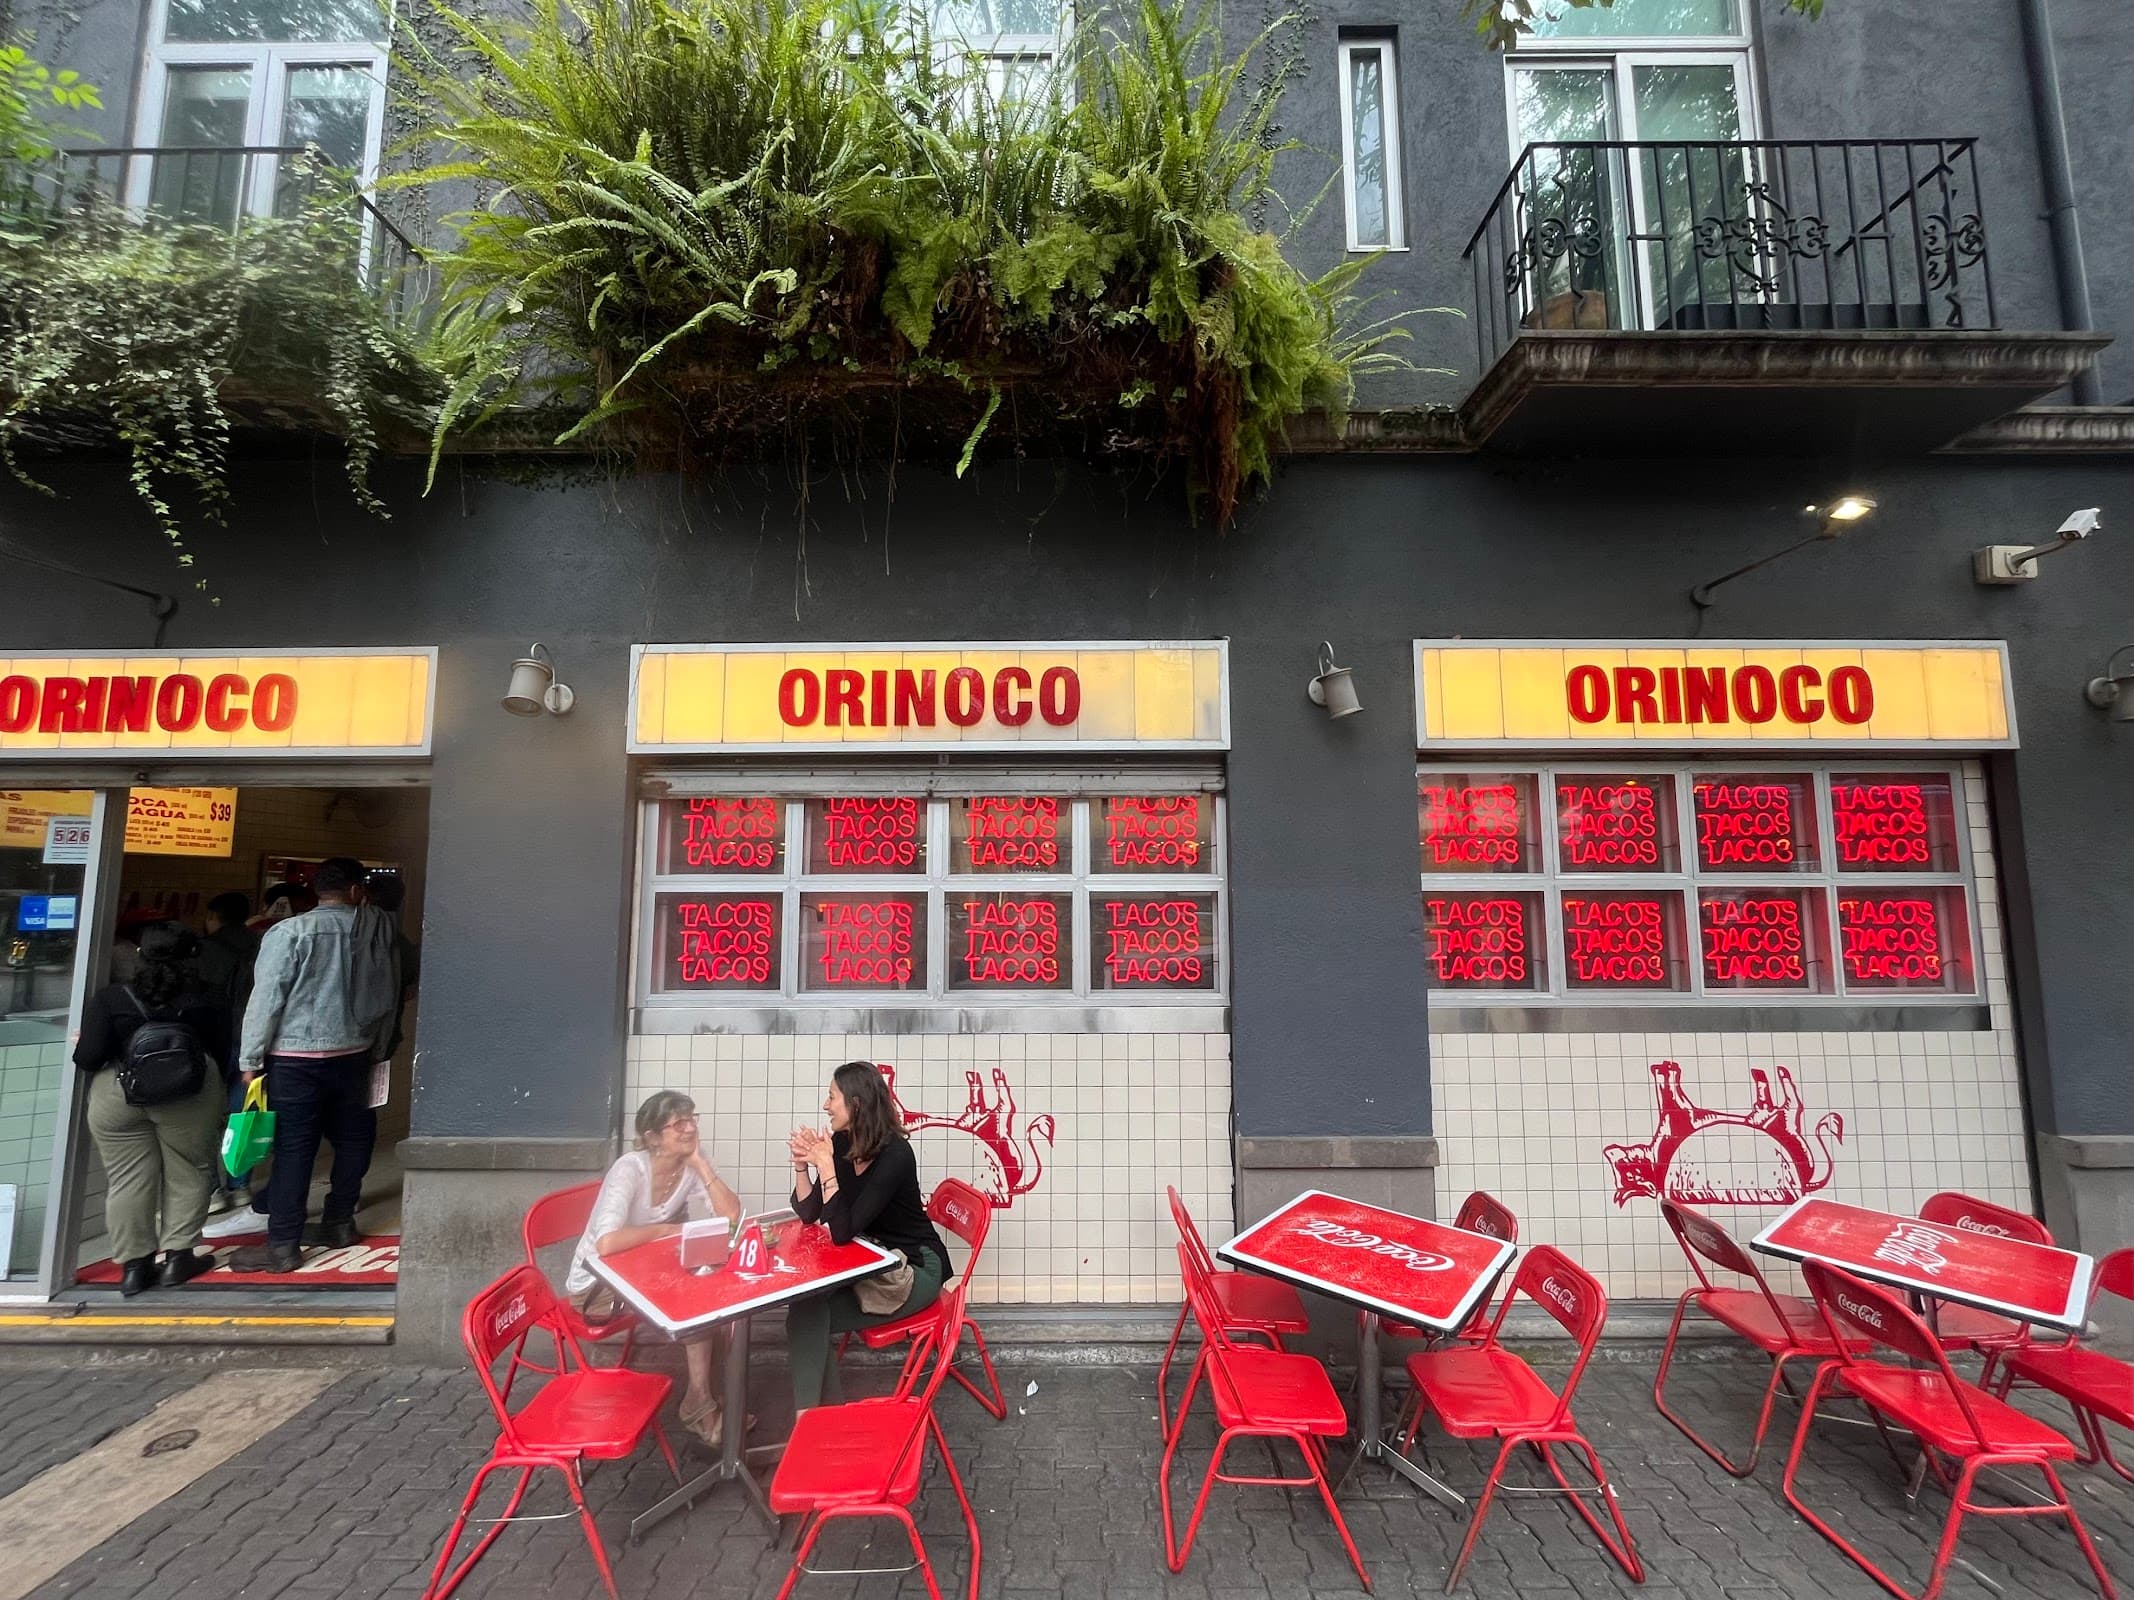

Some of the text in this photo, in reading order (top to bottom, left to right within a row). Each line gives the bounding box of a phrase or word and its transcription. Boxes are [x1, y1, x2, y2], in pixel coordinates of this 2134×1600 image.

[0, 674, 298, 734] ORINOCO
[778, 666, 1081, 727] ORINOCO
[1566, 665, 1874, 724] ORINOCO
[1423, 786, 1517, 810] TACOS
[1560, 787, 1655, 810] TACOS
[1694, 785, 1789, 809] TACOS
[1831, 786, 1923, 809] TACOS
[131, 807, 186, 819] AGUA
[1698, 813, 1790, 836] TACOS
[1834, 812, 1927, 836] TACOS
[682, 814, 777, 839] TACOS
[825, 815, 916, 839] TACOS
[966, 813, 1058, 838] TACOS
[1106, 815, 1198, 839] TACOS
[1426, 814, 1519, 837] TACOS
[1563, 814, 1655, 837] TACOS
[682, 842, 774, 867] TACOS
[825, 841, 916, 866] TACOS
[966, 841, 1058, 866] TACOS
[1108, 841, 1199, 865] TACOS
[1426, 839, 1520, 864] TACOS
[1564, 840, 1657, 864] TACOS
[1701, 839, 1793, 863] TACOS
[1836, 838, 1929, 862] TACOS
[679, 903, 772, 927] TACOS
[819, 903, 913, 928] TACOS
[964, 902, 1056, 926] TACOS
[1106, 902, 1198, 927] TACOS
[1428, 900, 1523, 926] TACOS
[1565, 901, 1662, 926] TACOS
[1703, 901, 1798, 924] TACOS
[1840, 901, 1935, 925] TACOS
[680, 931, 772, 955] TACOS
[821, 930, 911, 954] TACOS
[965, 930, 1058, 954] TACOS
[1107, 930, 1199, 954] TACOS
[1430, 929, 1524, 953] TACOS
[1568, 929, 1663, 953] TACOS
[1705, 928, 1801, 952] TACOS
[1841, 928, 1937, 952] TACOS
[678, 957, 770, 982] TACOS
[819, 958, 912, 982] TACOS
[964, 957, 1058, 982] TACOS
[1106, 957, 1201, 982] TACOS
[1430, 956, 1526, 980] TACOS
[1572, 957, 1664, 980] TACOS
[1706, 955, 1804, 979] TACOS
[1844, 955, 1941, 979] TACOS
[739, 1239, 758, 1267] 18
